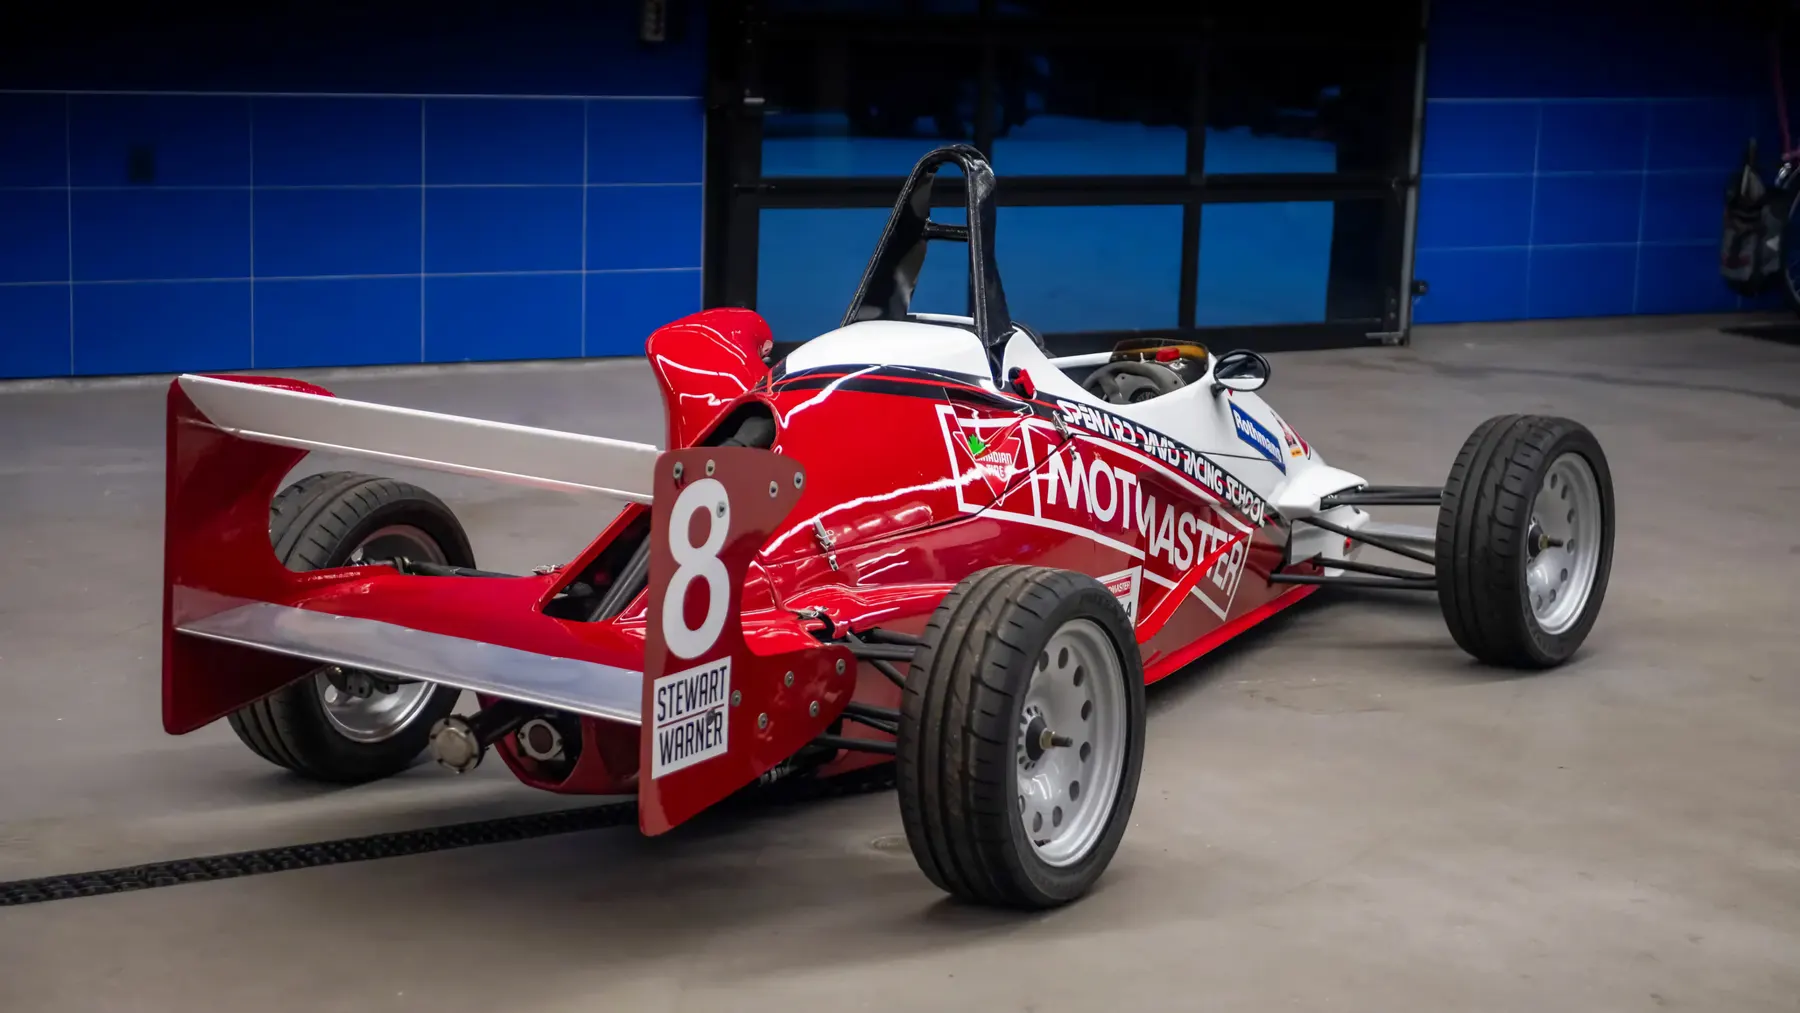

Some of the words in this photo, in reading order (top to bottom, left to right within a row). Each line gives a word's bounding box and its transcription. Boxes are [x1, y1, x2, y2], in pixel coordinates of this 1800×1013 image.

[976, 451, 1013, 465] NADIAN
[1057, 399, 1139, 447] SPENARD
[1136, 426, 1180, 467] DAVID
[1181, 447, 1224, 496] RACING
[1225, 474, 1266, 528] SCHOOL
[1233, 409, 1282, 463] Rothmans
[662, 477, 731, 660] 8
[657, 665, 728, 722] STEWART
[659, 709, 724, 767] WARNER
